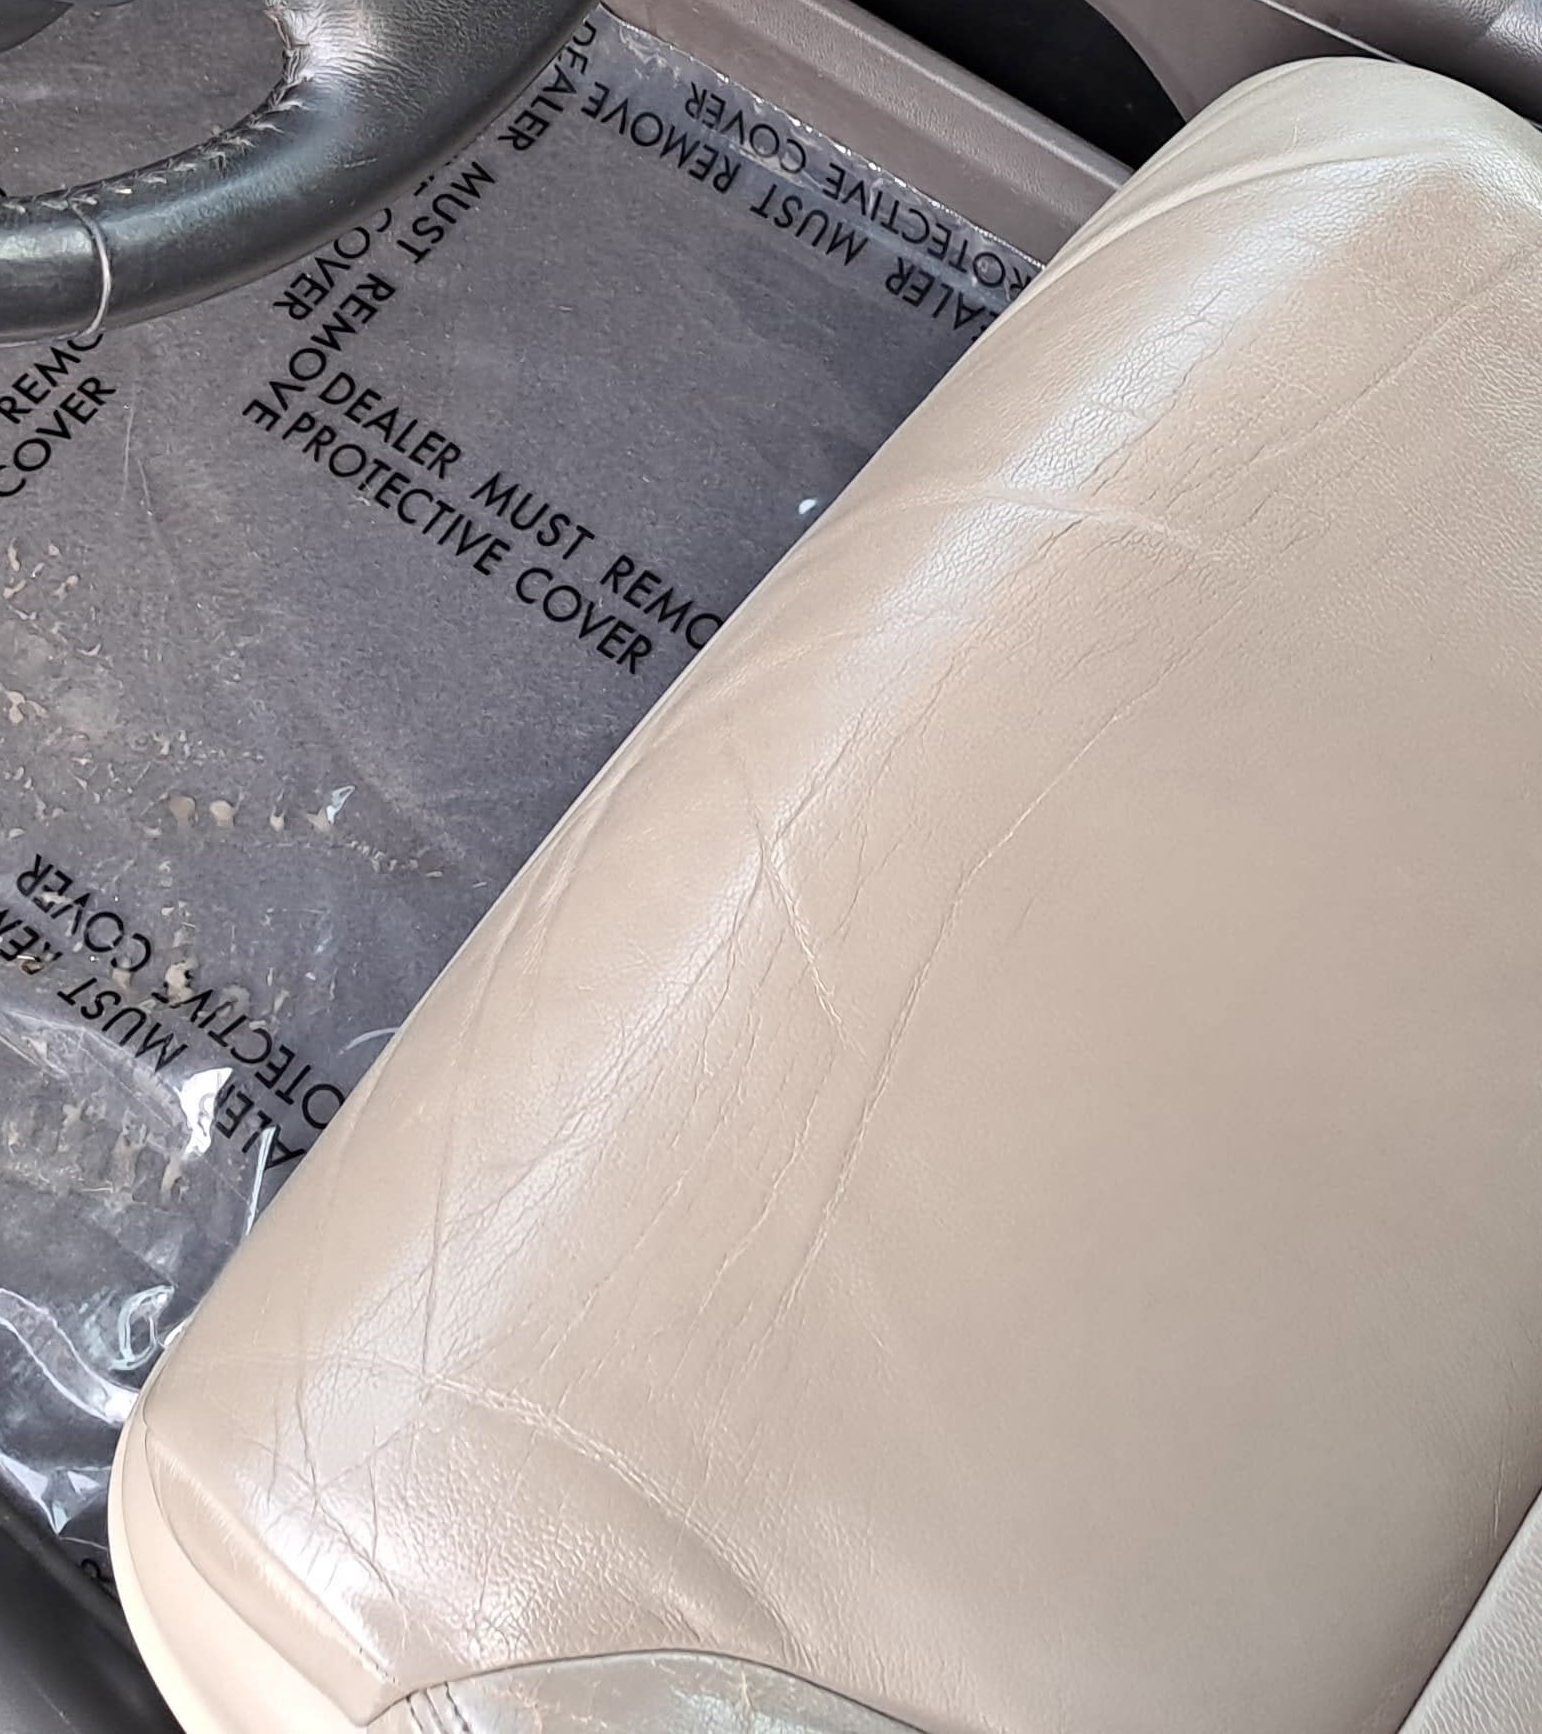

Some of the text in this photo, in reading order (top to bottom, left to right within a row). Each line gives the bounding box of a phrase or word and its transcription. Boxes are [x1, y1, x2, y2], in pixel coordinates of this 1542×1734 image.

[396, 161, 496, 264] MUST
[580, 81, 990, 342] ALER MUST REMOVE
[685, 81, 1034, 301] ROTECTIVE COVER
[242, 273, 396, 433] REMOVE
[281, 411, 653, 675] PROTECTIVE COVER
[318, 371, 726, 651] DEALER MUST REMO
[15, 854, 151, 973] COVER
[57, 977, 189, 1073] MUST
